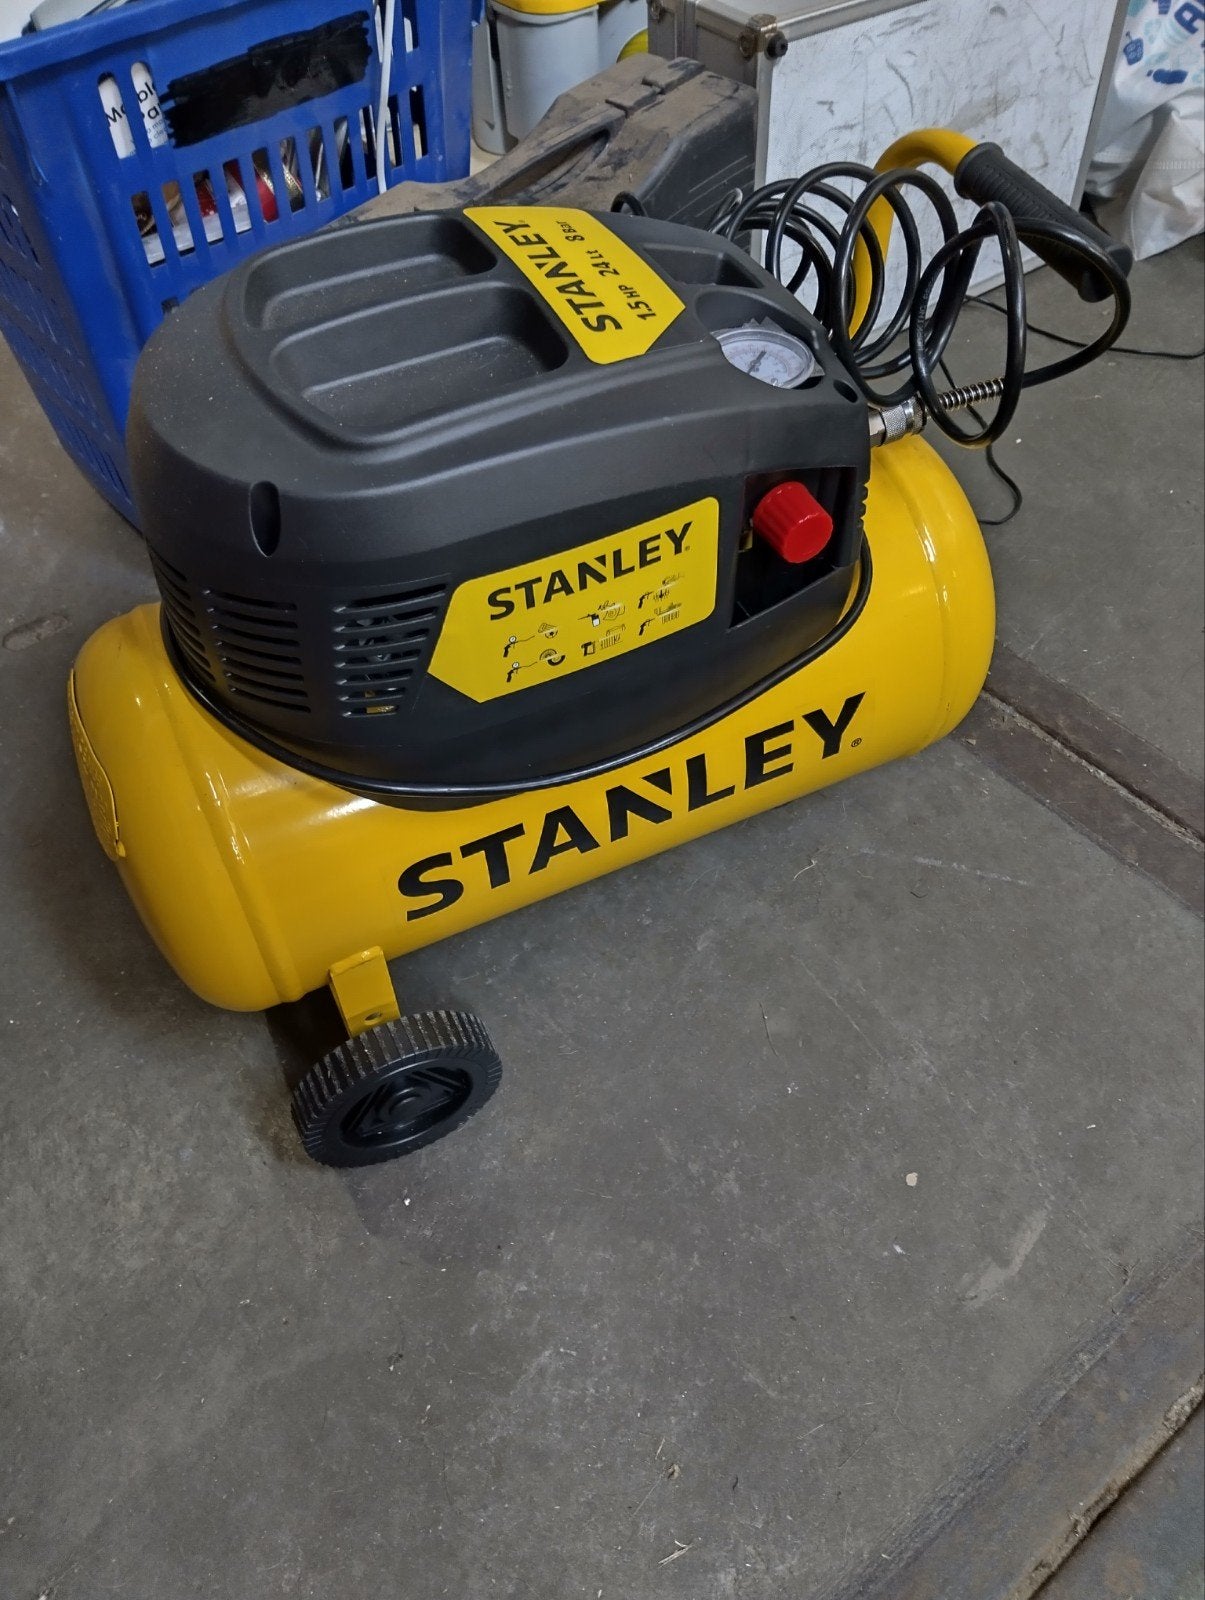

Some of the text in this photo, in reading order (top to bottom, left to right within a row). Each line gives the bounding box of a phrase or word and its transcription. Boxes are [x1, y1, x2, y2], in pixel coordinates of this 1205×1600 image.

[556, 220, 577, 234] Bar
[493, 220, 623, 332] STANLEY
[591, 261, 620, 277] 24
[618, 284, 640, 299] HP
[627, 300, 657, 321] 1.5
[487, 521, 693, 621] STANLEY
[397, 691, 866, 922] STANLEY
